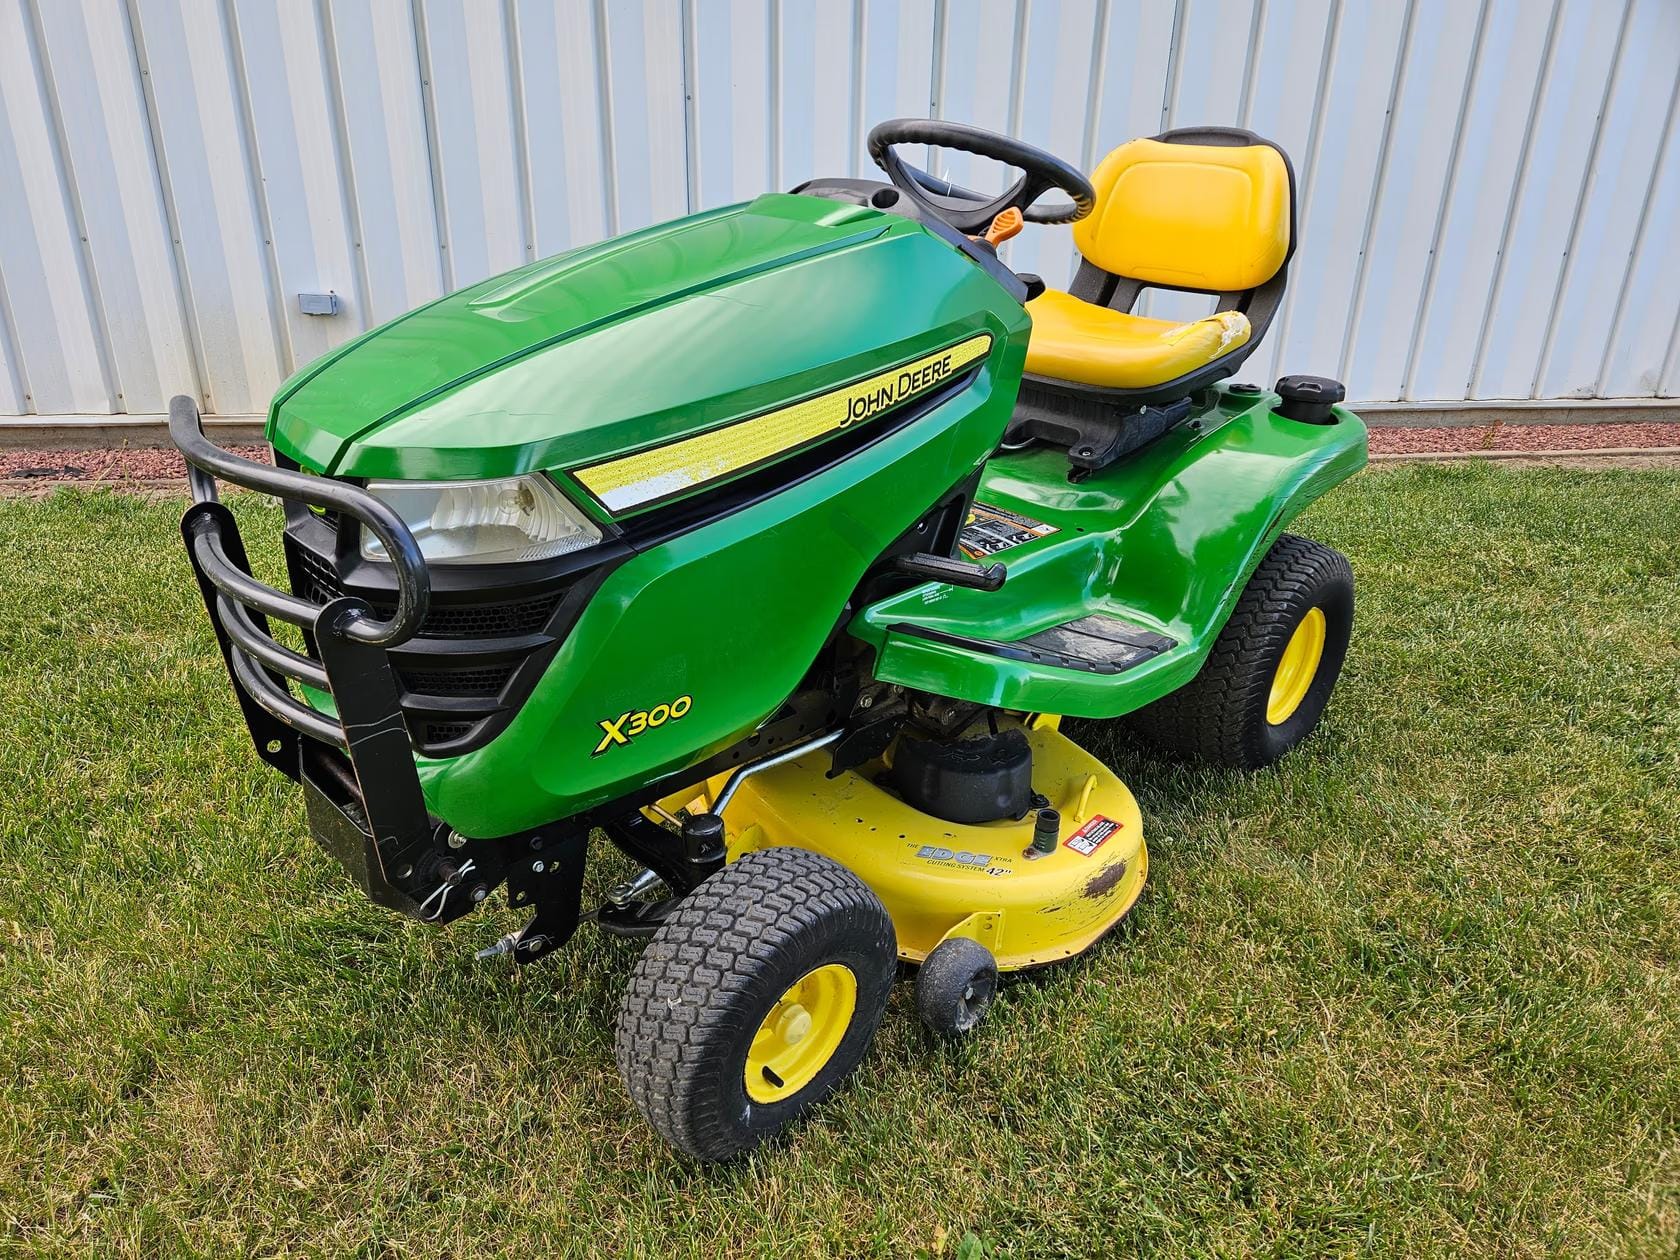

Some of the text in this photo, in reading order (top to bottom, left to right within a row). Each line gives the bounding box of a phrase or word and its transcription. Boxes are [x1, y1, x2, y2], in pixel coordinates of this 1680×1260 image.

[839, 355, 952, 427] JOHN DEERE
[591, 695, 693, 756] X300
[915, 845, 993, 867] EDGE
[926, 859, 1012, 877] CUTTING SYSTEM 42"
